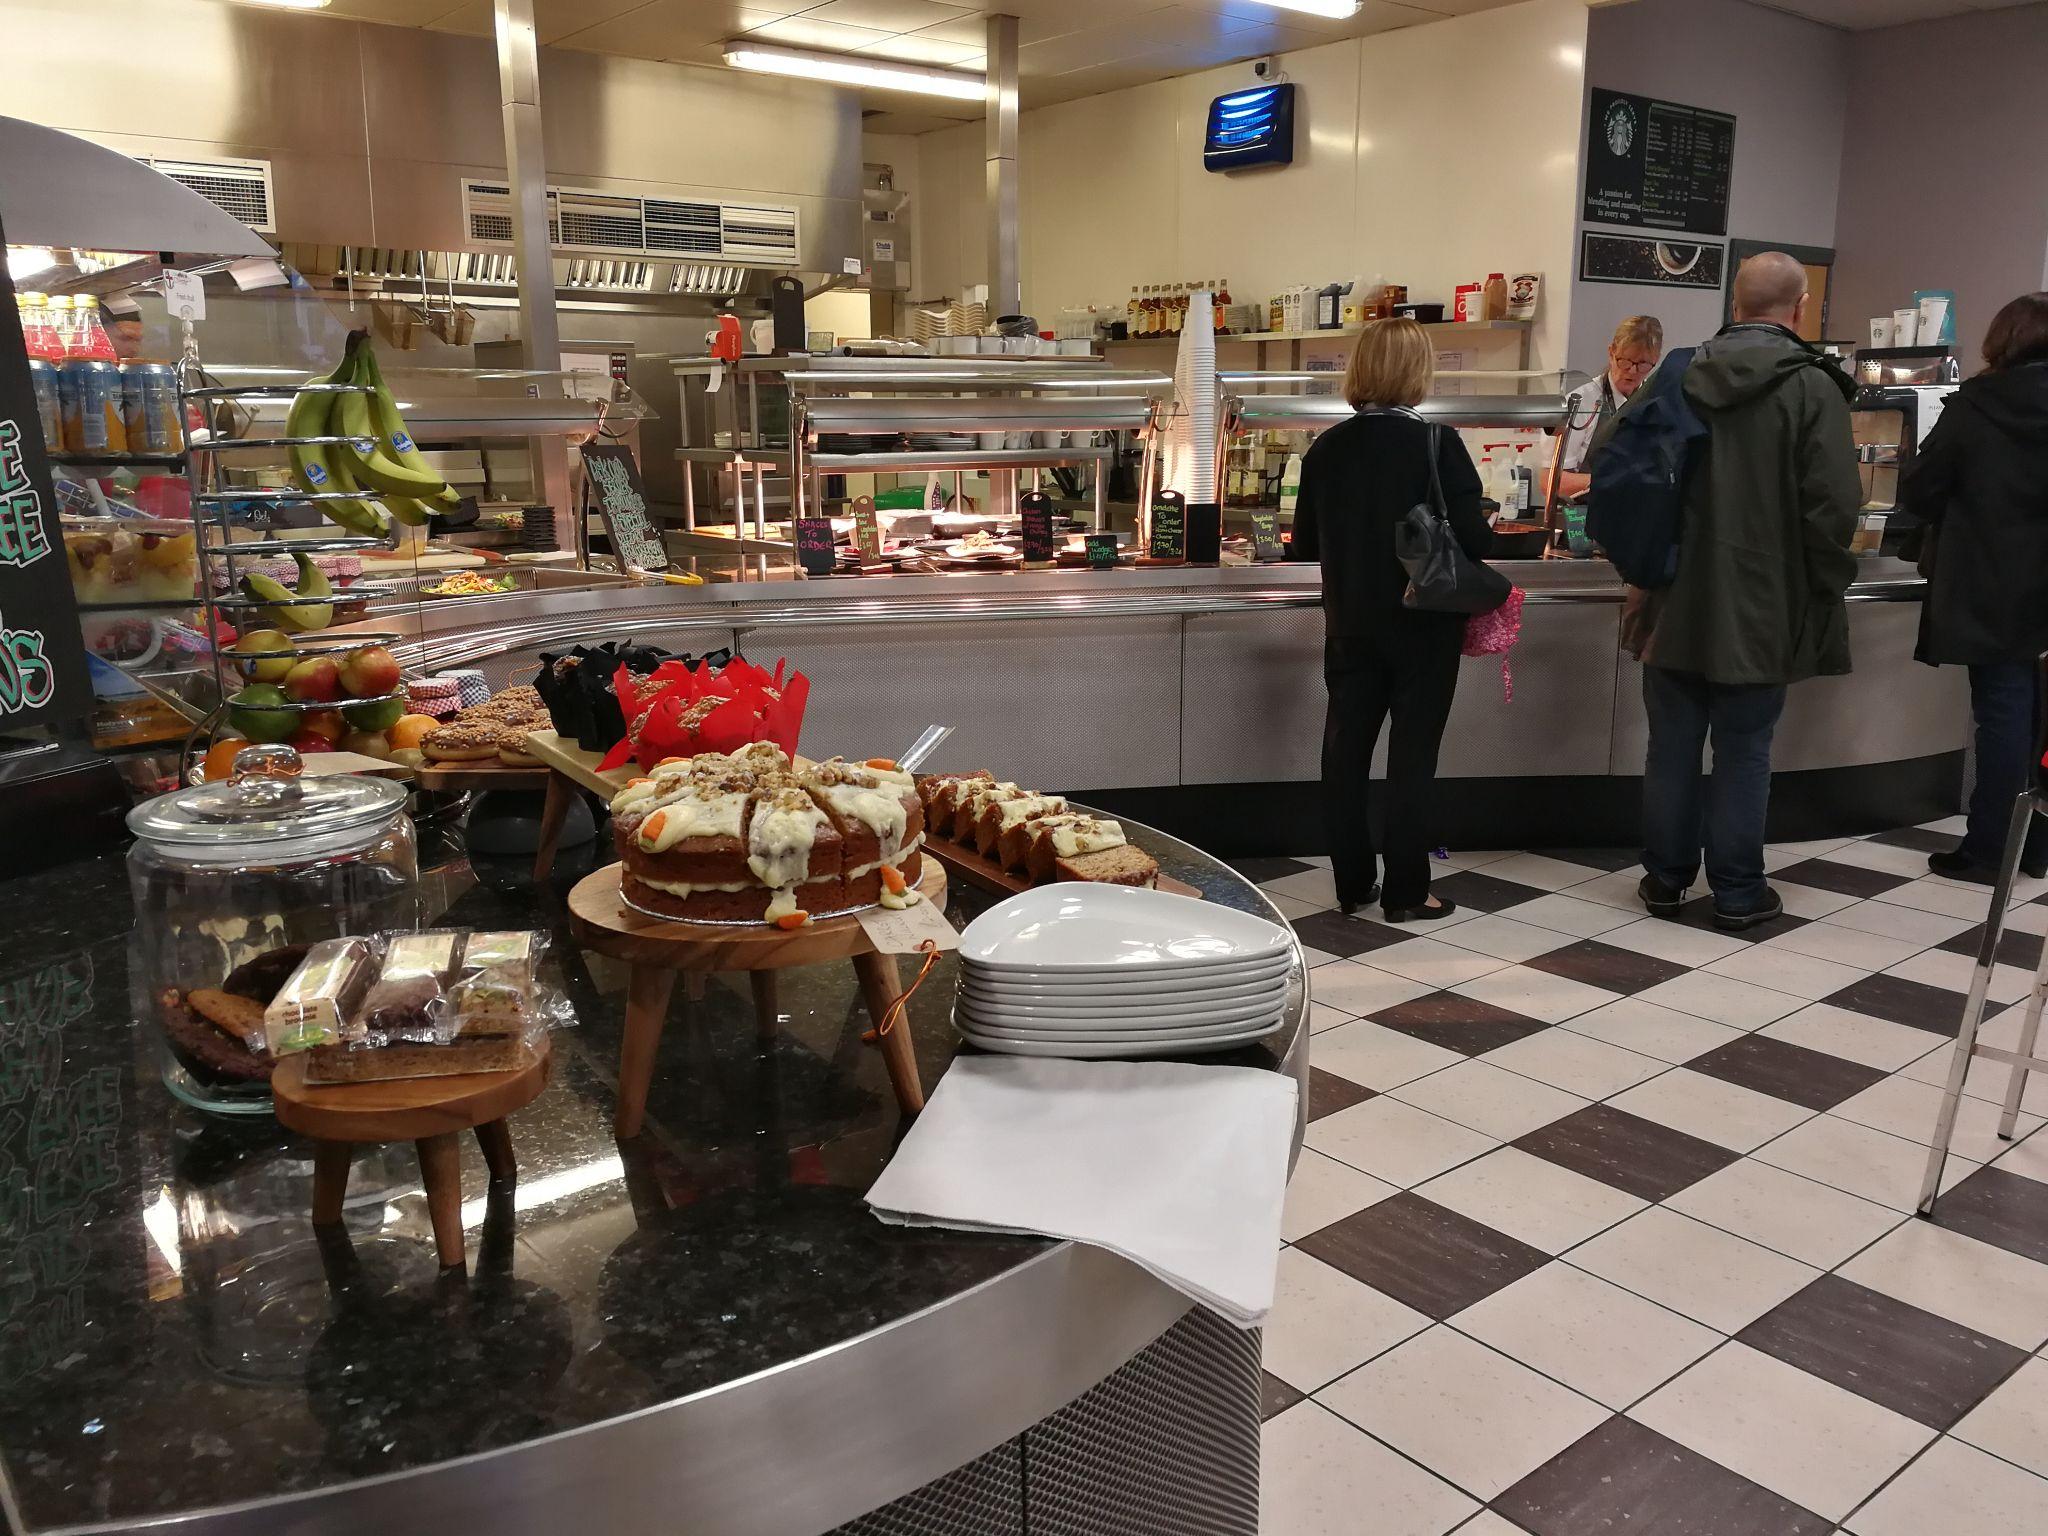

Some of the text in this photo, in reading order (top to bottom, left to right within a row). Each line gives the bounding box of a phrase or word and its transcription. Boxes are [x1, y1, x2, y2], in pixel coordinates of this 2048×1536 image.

[798, 519, 828, 529] SNACKS
[800, 539, 833, 551] ORDER
[282, 1005, 318, 1017] choclate
[285, 1013, 317, 1026] bronie
